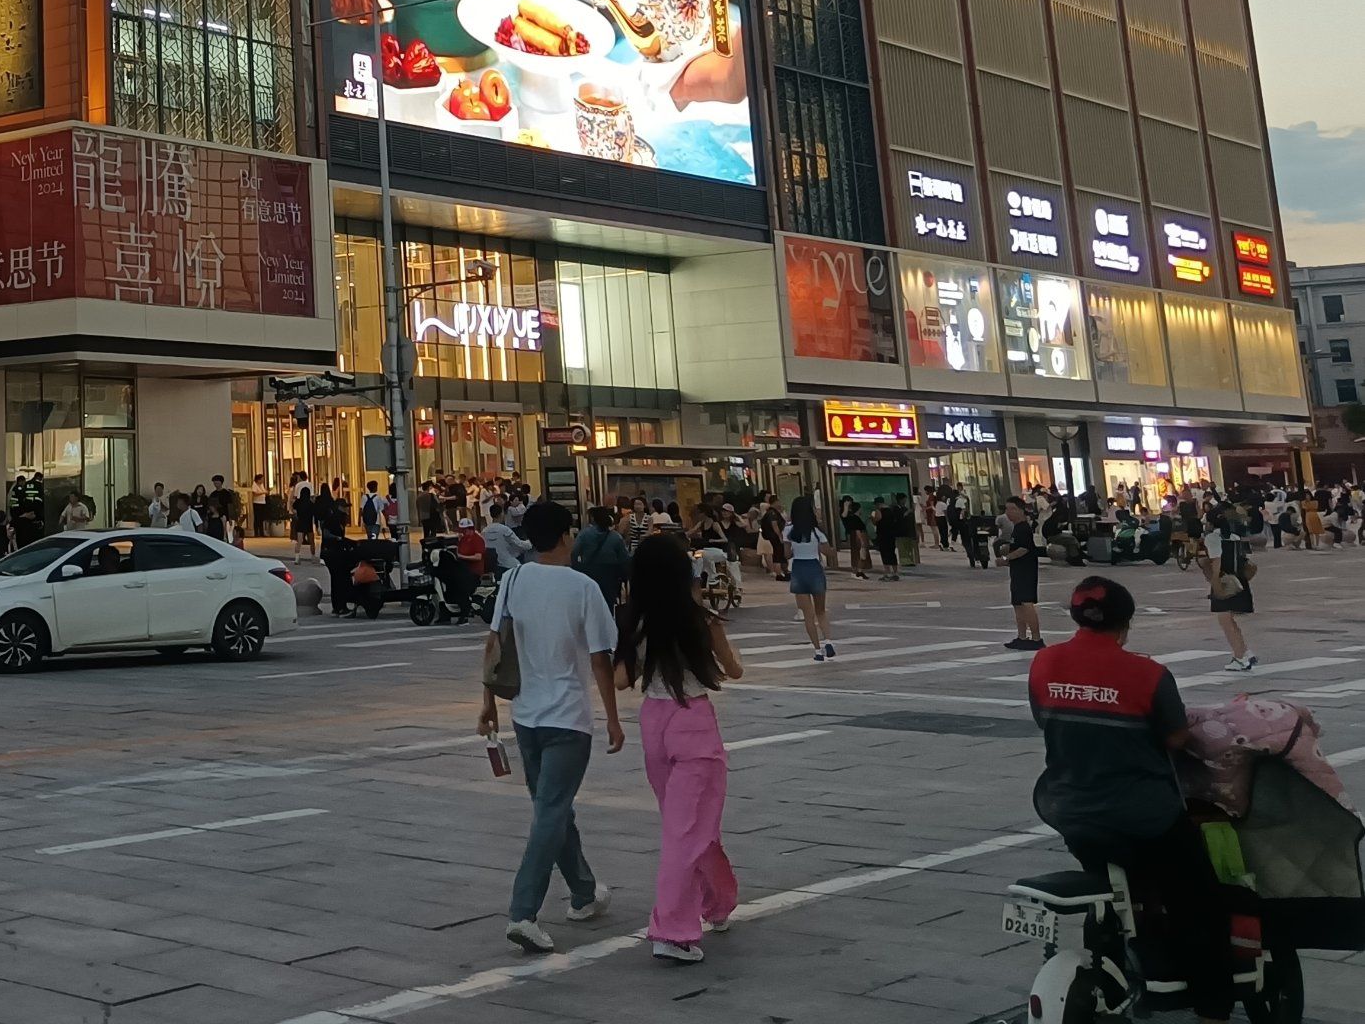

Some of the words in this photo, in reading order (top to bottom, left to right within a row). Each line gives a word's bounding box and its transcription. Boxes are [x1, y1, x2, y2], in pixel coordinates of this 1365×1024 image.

[11, 150, 37, 167] New
[39, 146, 64, 163] Year
[37, 181, 64, 196] 2024
[239, 169, 263, 191] Ber
[240, 196, 302, 226] 有意思节
[282, 254, 304, 270] Year
[266, 267, 306, 286] Limited
[282, 288, 306, 305] 2024
[1047, 682, 1120, 705] 京东家政
[1005, 917, 1051, 941] D24392
